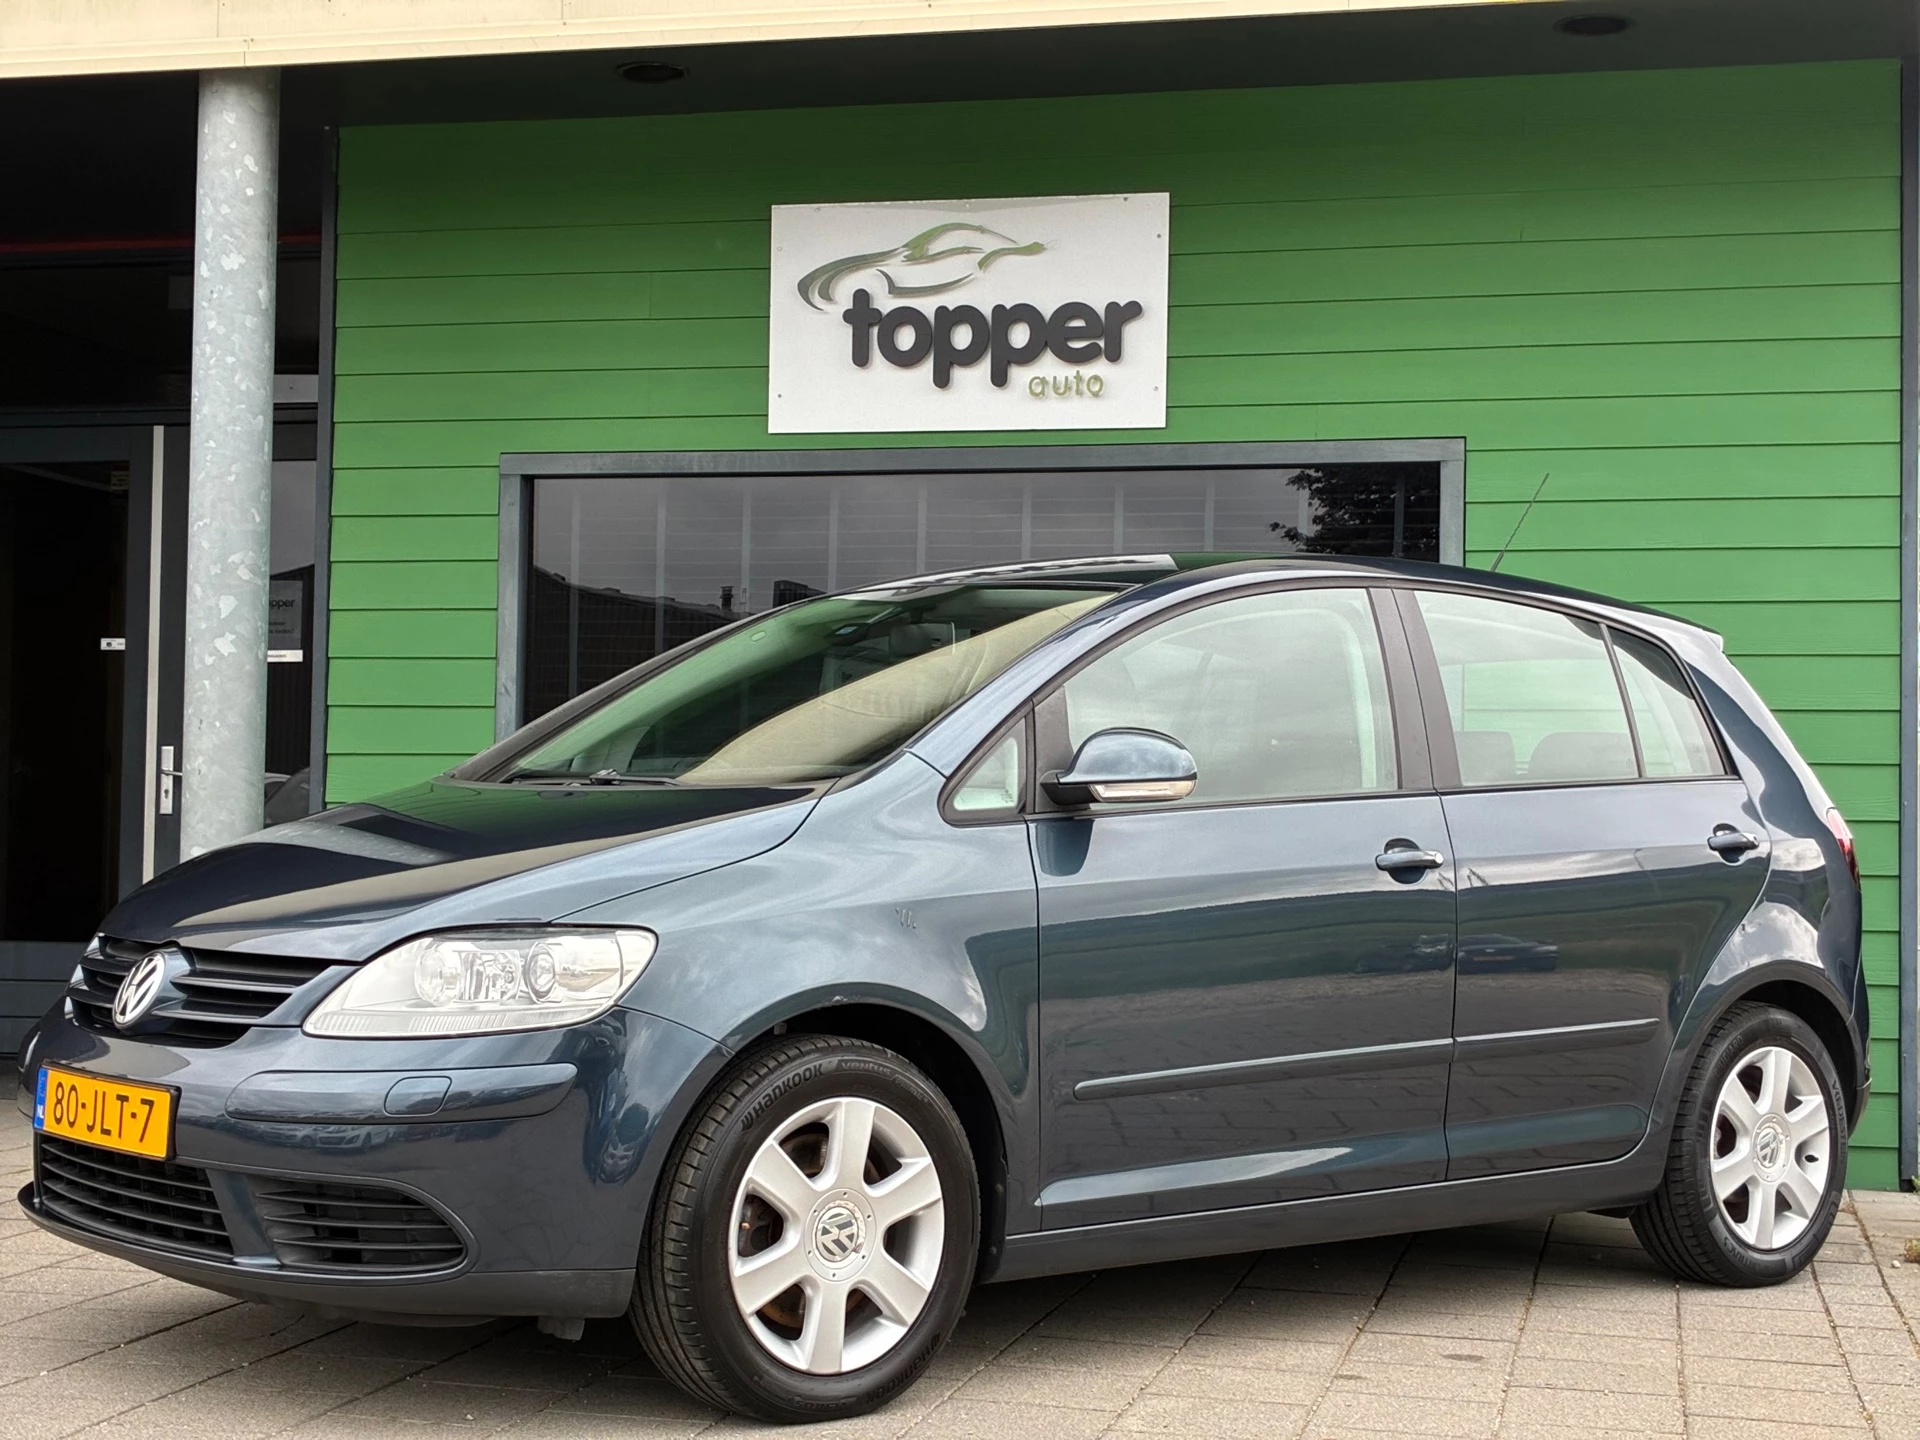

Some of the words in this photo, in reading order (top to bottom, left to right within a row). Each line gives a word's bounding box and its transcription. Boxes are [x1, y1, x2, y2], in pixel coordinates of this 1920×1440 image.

[842, 288, 1143, 389] topper
[1028, 370, 1105, 398] auto
[269, 598, 296, 611] pper
[53, 1081, 155, 1143] 80-JLT-7
